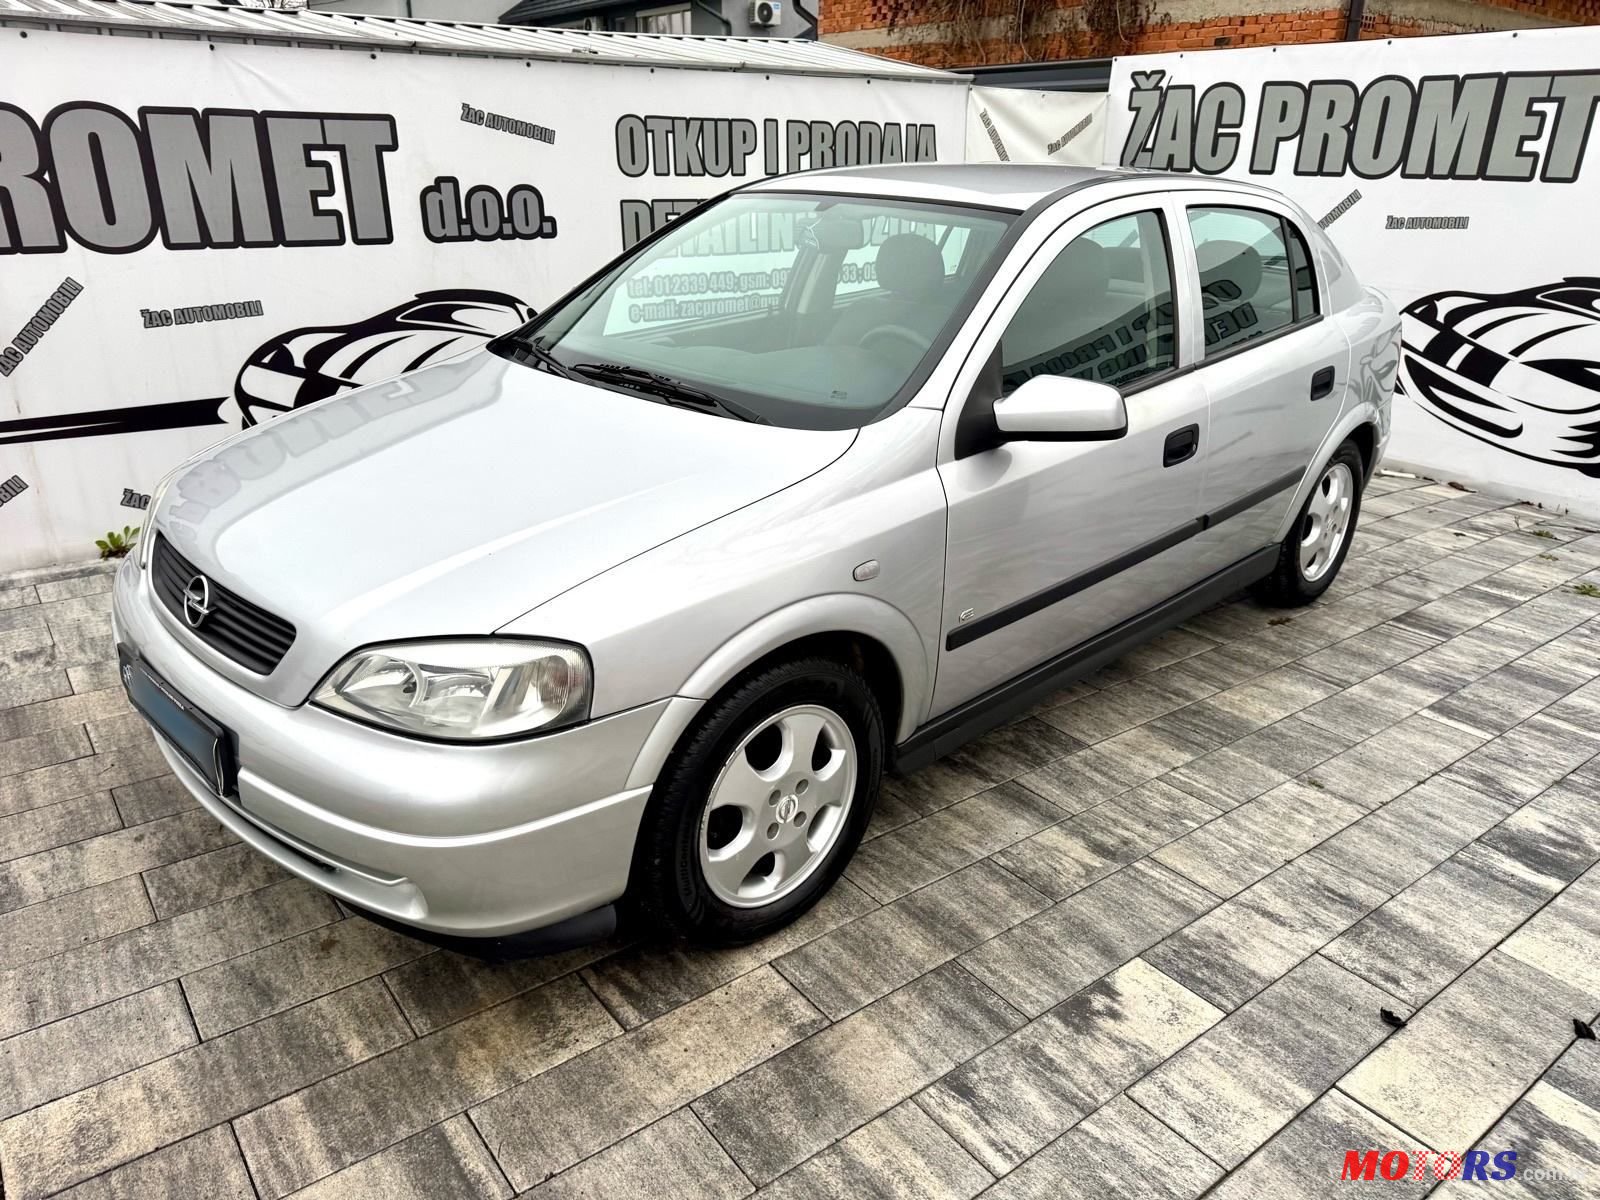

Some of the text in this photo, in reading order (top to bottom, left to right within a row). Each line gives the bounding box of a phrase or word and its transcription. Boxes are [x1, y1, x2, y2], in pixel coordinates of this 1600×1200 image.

[460, 102, 556, 145] ŽAC AUTOMOBILI
[615, 114, 758, 178] OTKUP
[763, 118, 779, 176] I
[1120, 69, 1600, 183] ŽAC PROMET
[420, 176, 558, 243] d.o.o.
[1405, 216, 1470, 230] AUTOMOBILI
[11, 276, 85, 355] AUTOMOBILI
[140, 300, 264, 329] ŽAC AUTOMOBILI
[120, 488, 151, 511] ŽAC
